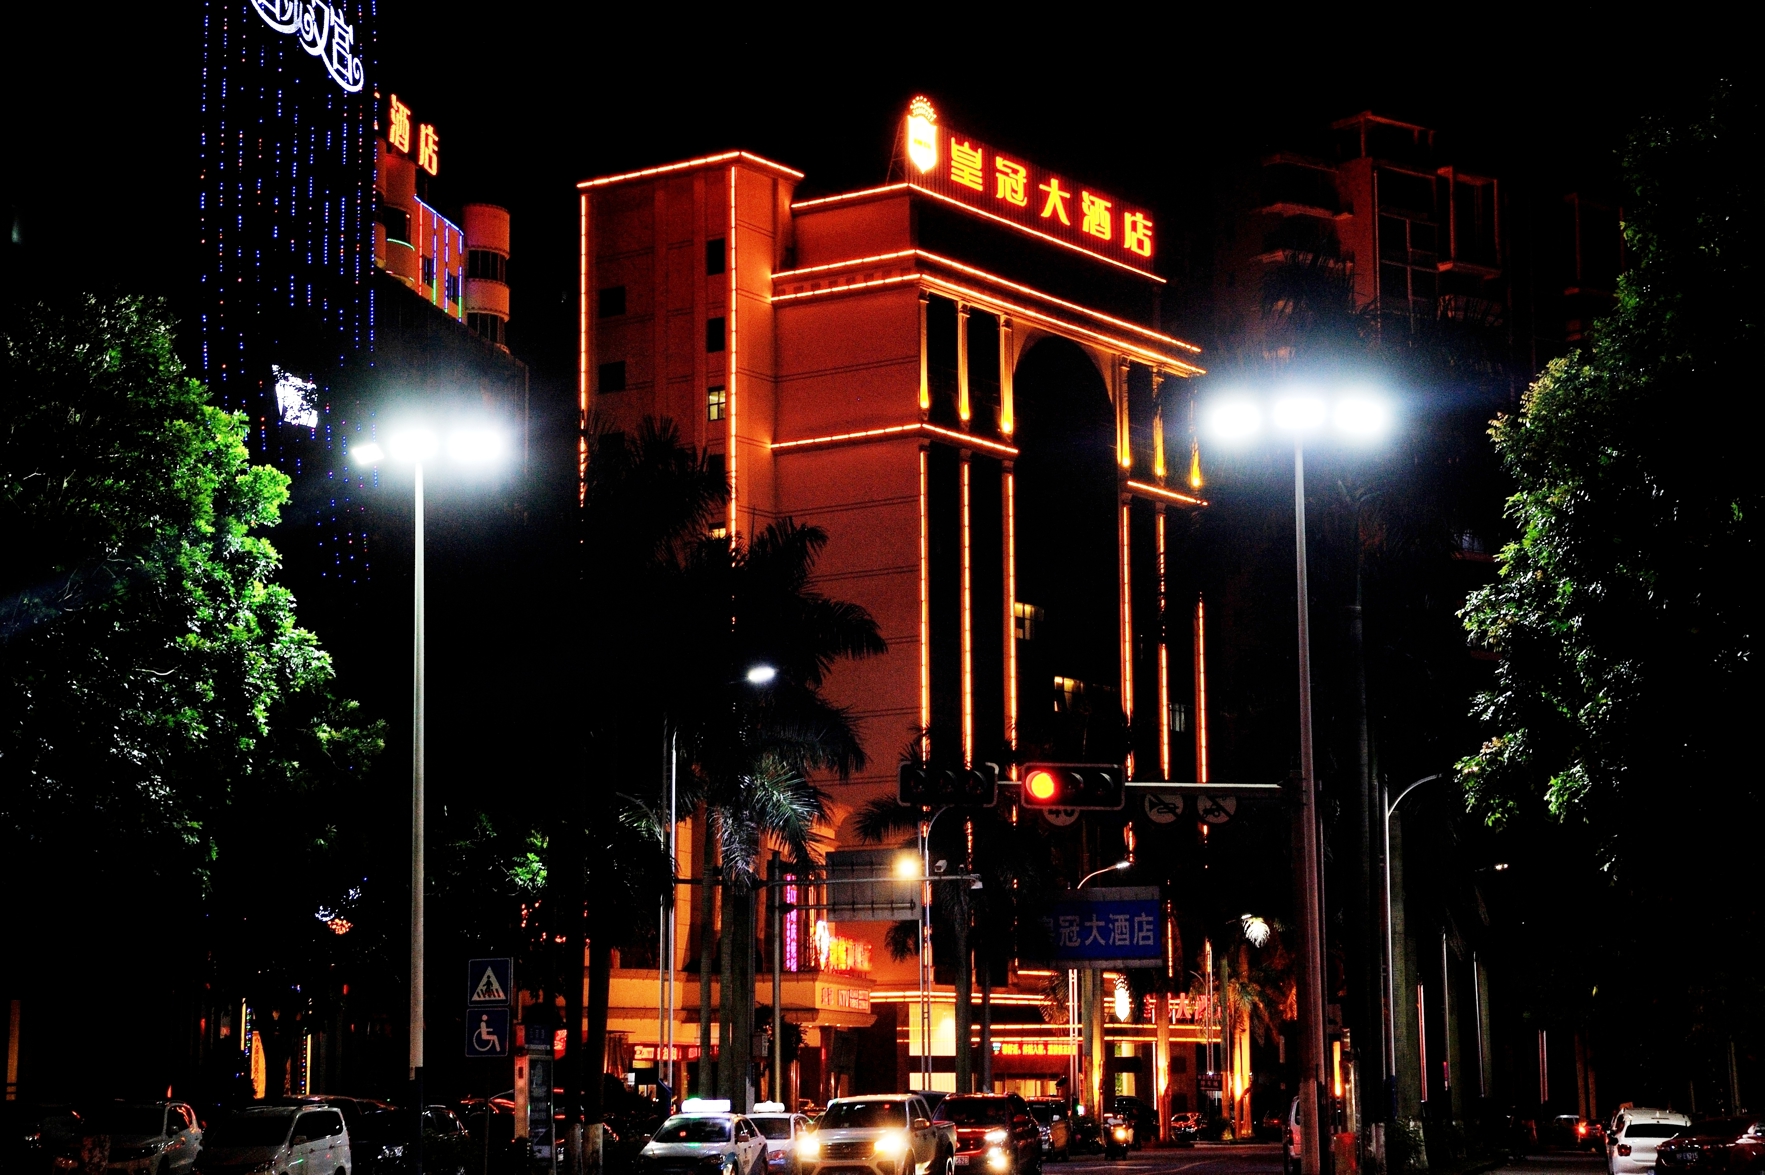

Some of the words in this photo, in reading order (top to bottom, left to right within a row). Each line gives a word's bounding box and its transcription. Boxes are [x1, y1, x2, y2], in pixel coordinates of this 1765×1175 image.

[374, 92, 440, 177] 酒店
[951, 137, 1153, 258] 皇冠大酒店
